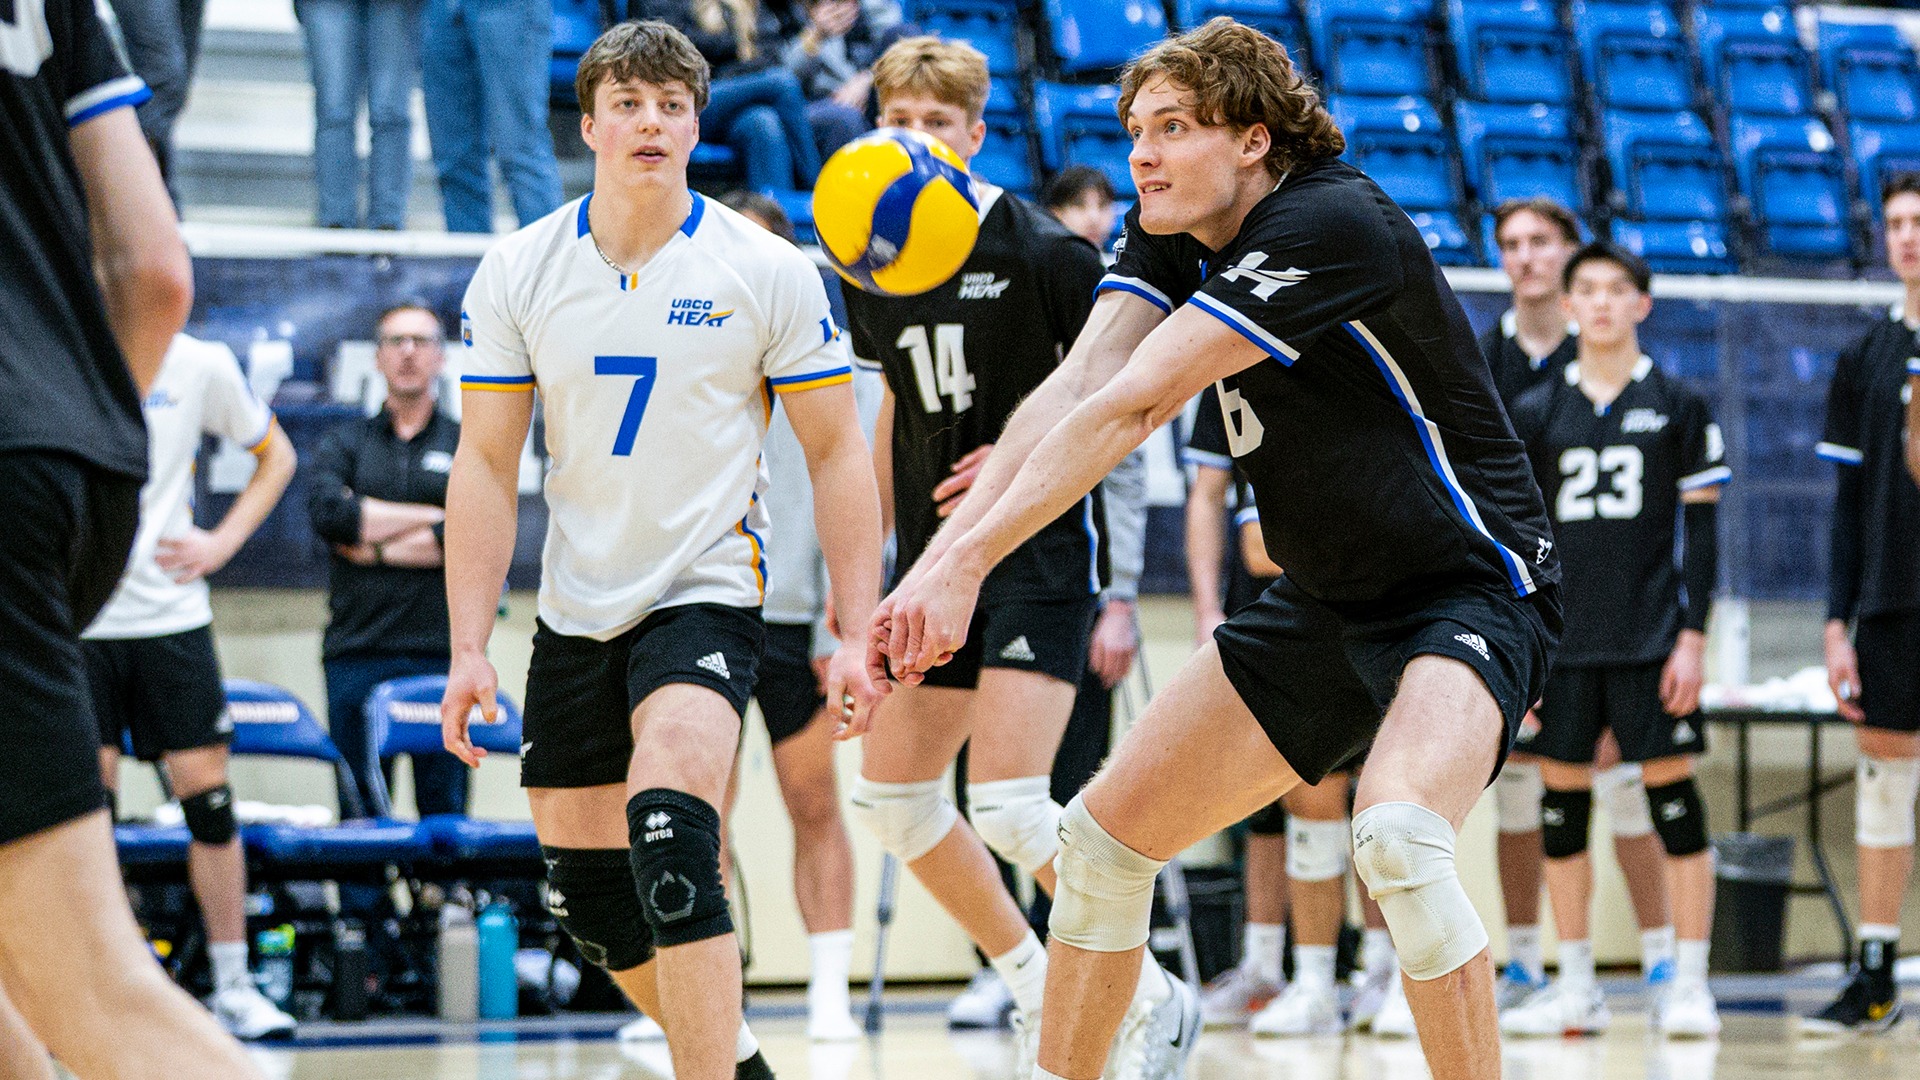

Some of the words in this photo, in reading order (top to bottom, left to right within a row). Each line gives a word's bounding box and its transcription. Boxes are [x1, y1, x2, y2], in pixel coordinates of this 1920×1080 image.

[667, 308, 735, 327] HEAT
[671, 298, 713, 310] UBCO
[896, 323, 977, 413] 14
[594, 355, 657, 456] 7
[1555, 445, 1644, 523] 23
[1454, 634, 1490, 661] adidas
[696, 658, 730, 679] adidas
